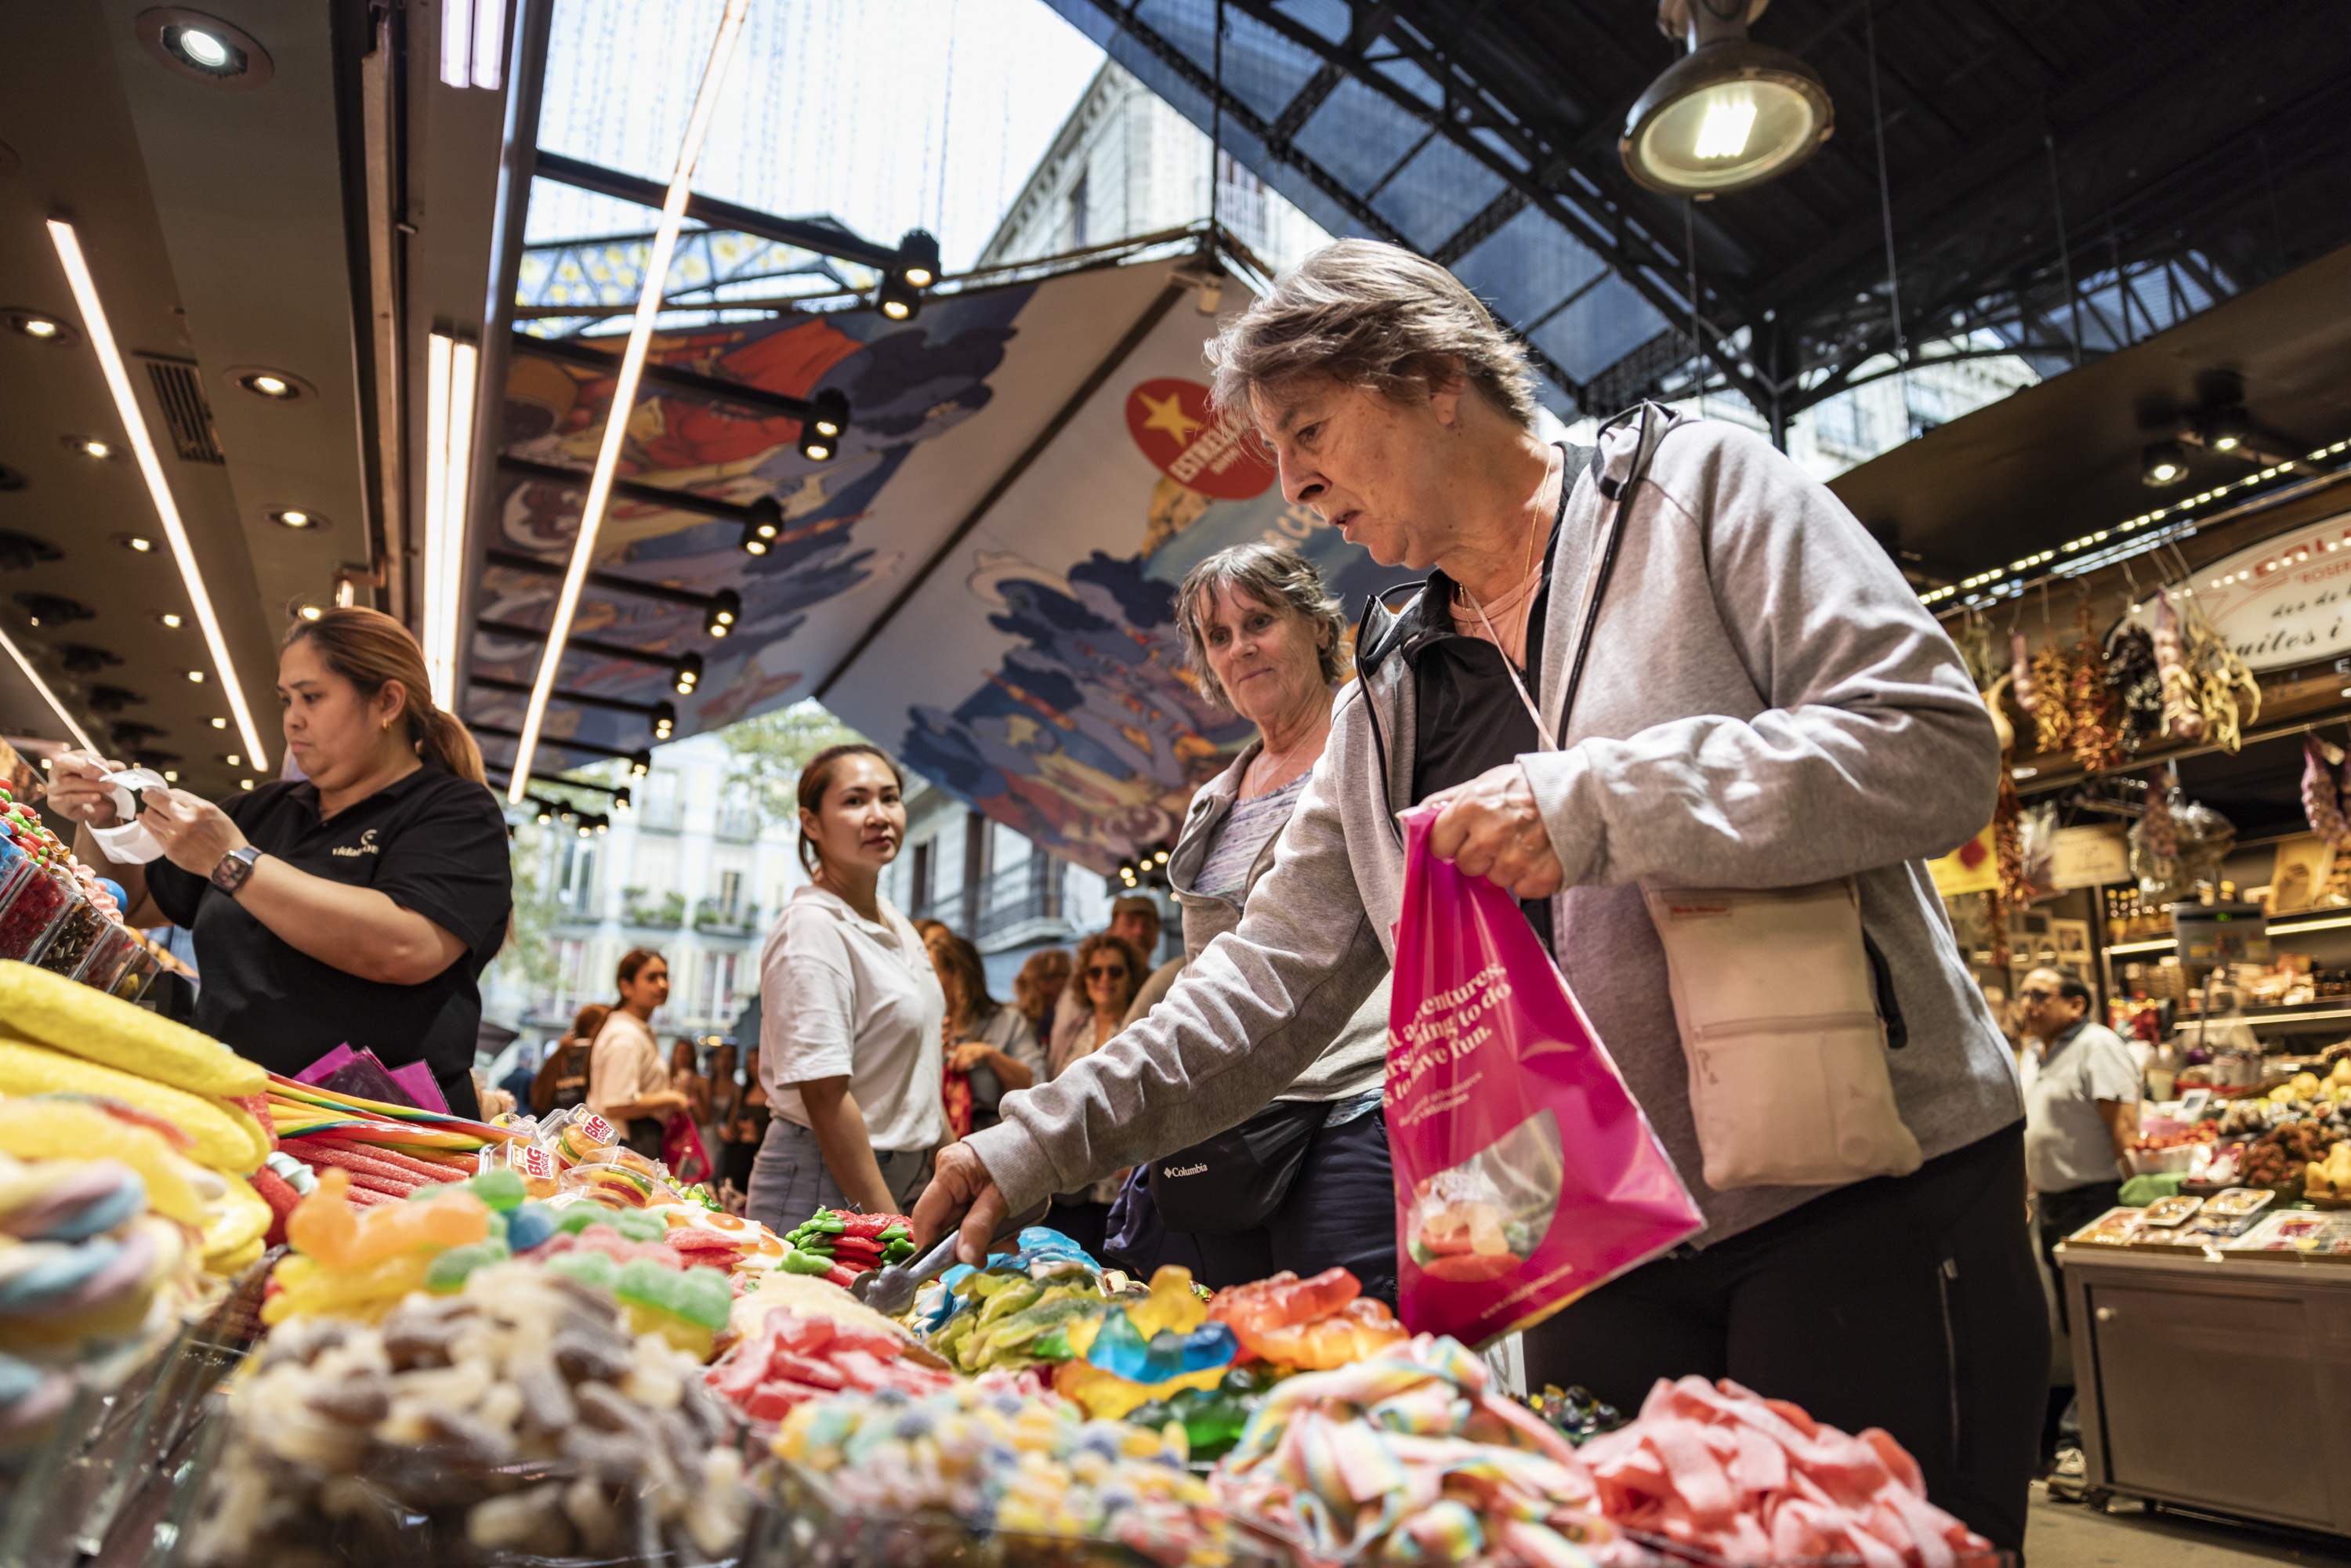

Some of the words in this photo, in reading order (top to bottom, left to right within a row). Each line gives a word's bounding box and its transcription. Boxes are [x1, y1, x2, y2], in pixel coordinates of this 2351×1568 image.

[1458, 1004, 1481, 1027] to
[1481, 983, 1512, 1009] do
[1449, 1026, 1492, 1059] fun.
[585, 1116, 607, 1141] BIG
[527, 1147, 542, 1176] BIG
[542, 1153, 551, 1178] BURGER
[1172, 1163, 1208, 1177] Columbia
